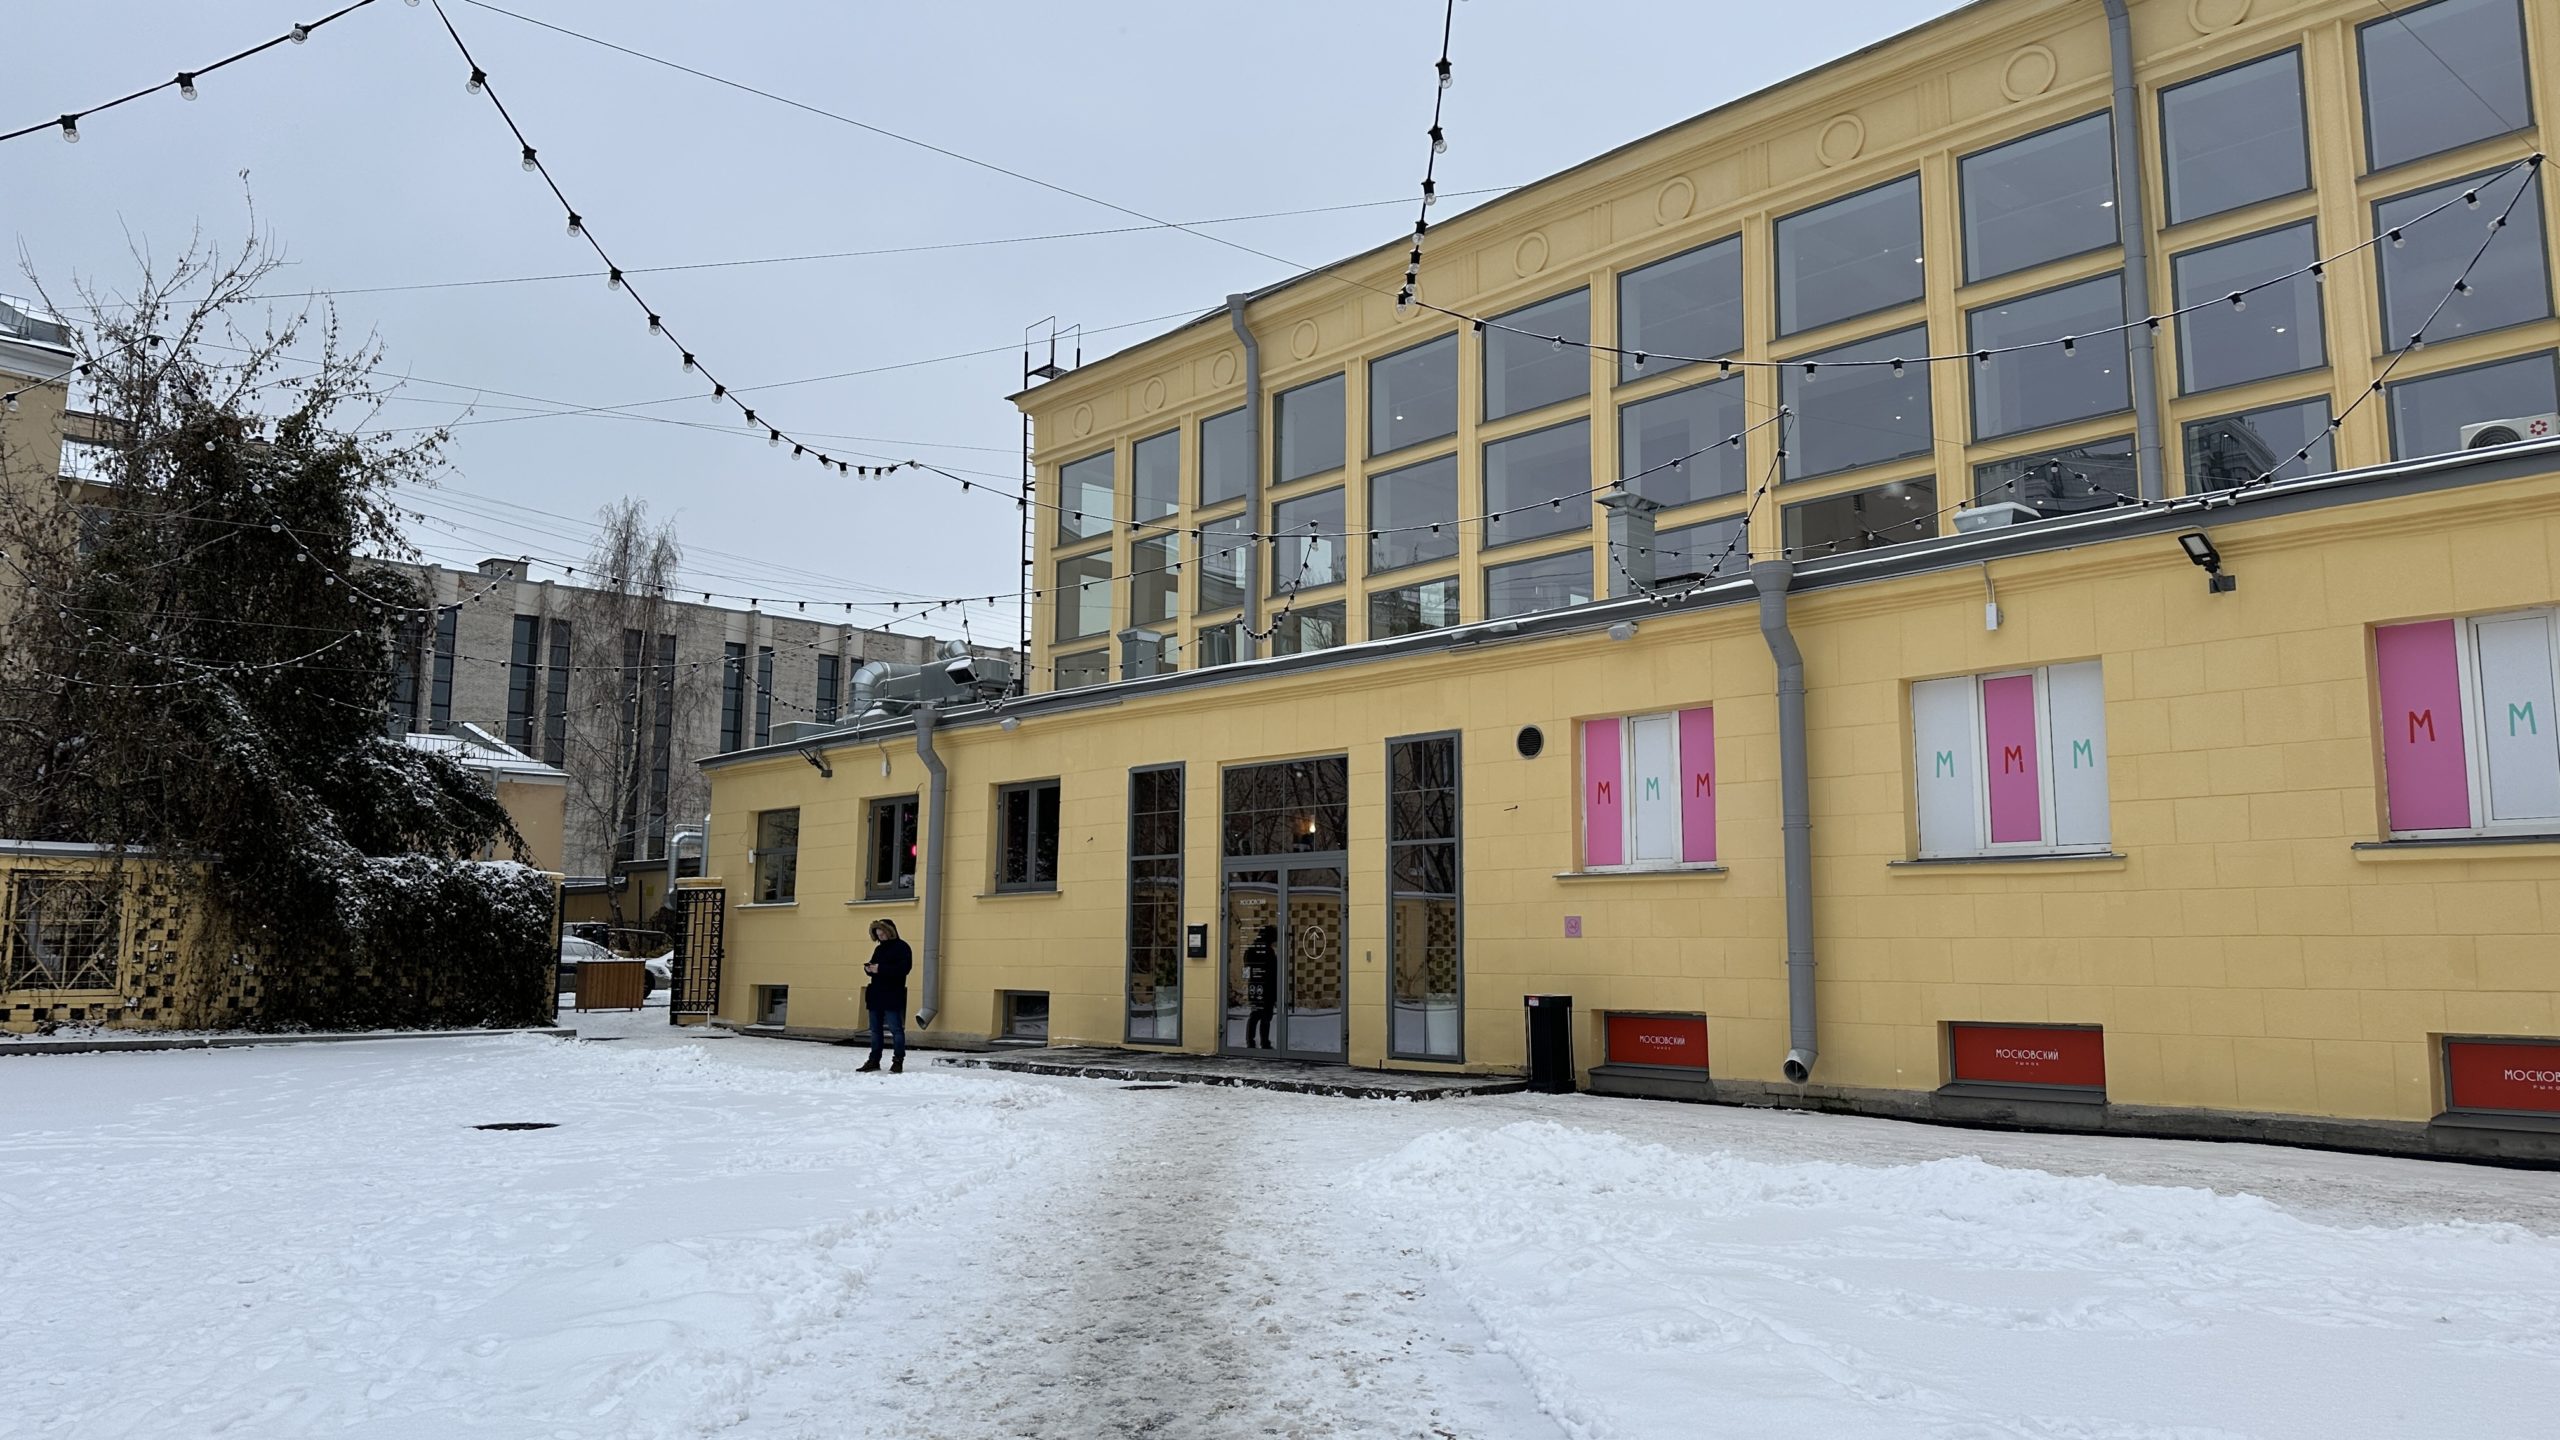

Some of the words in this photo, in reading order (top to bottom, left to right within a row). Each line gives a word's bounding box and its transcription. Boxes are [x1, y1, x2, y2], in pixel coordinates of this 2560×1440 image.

[2409, 709, 2435, 743] М
[2509, 701, 2537, 736] М
[1936, 750, 1954, 778] М
[2004, 745, 2024, 774] М
[2073, 739, 2093, 769] М
[1597, 781, 1611, 804] М
[1646, 776, 1659, 801] М
[1696, 772, 1710, 797] М
[1996, 1048, 2058, 1060] МОСКОВСКИЙ
